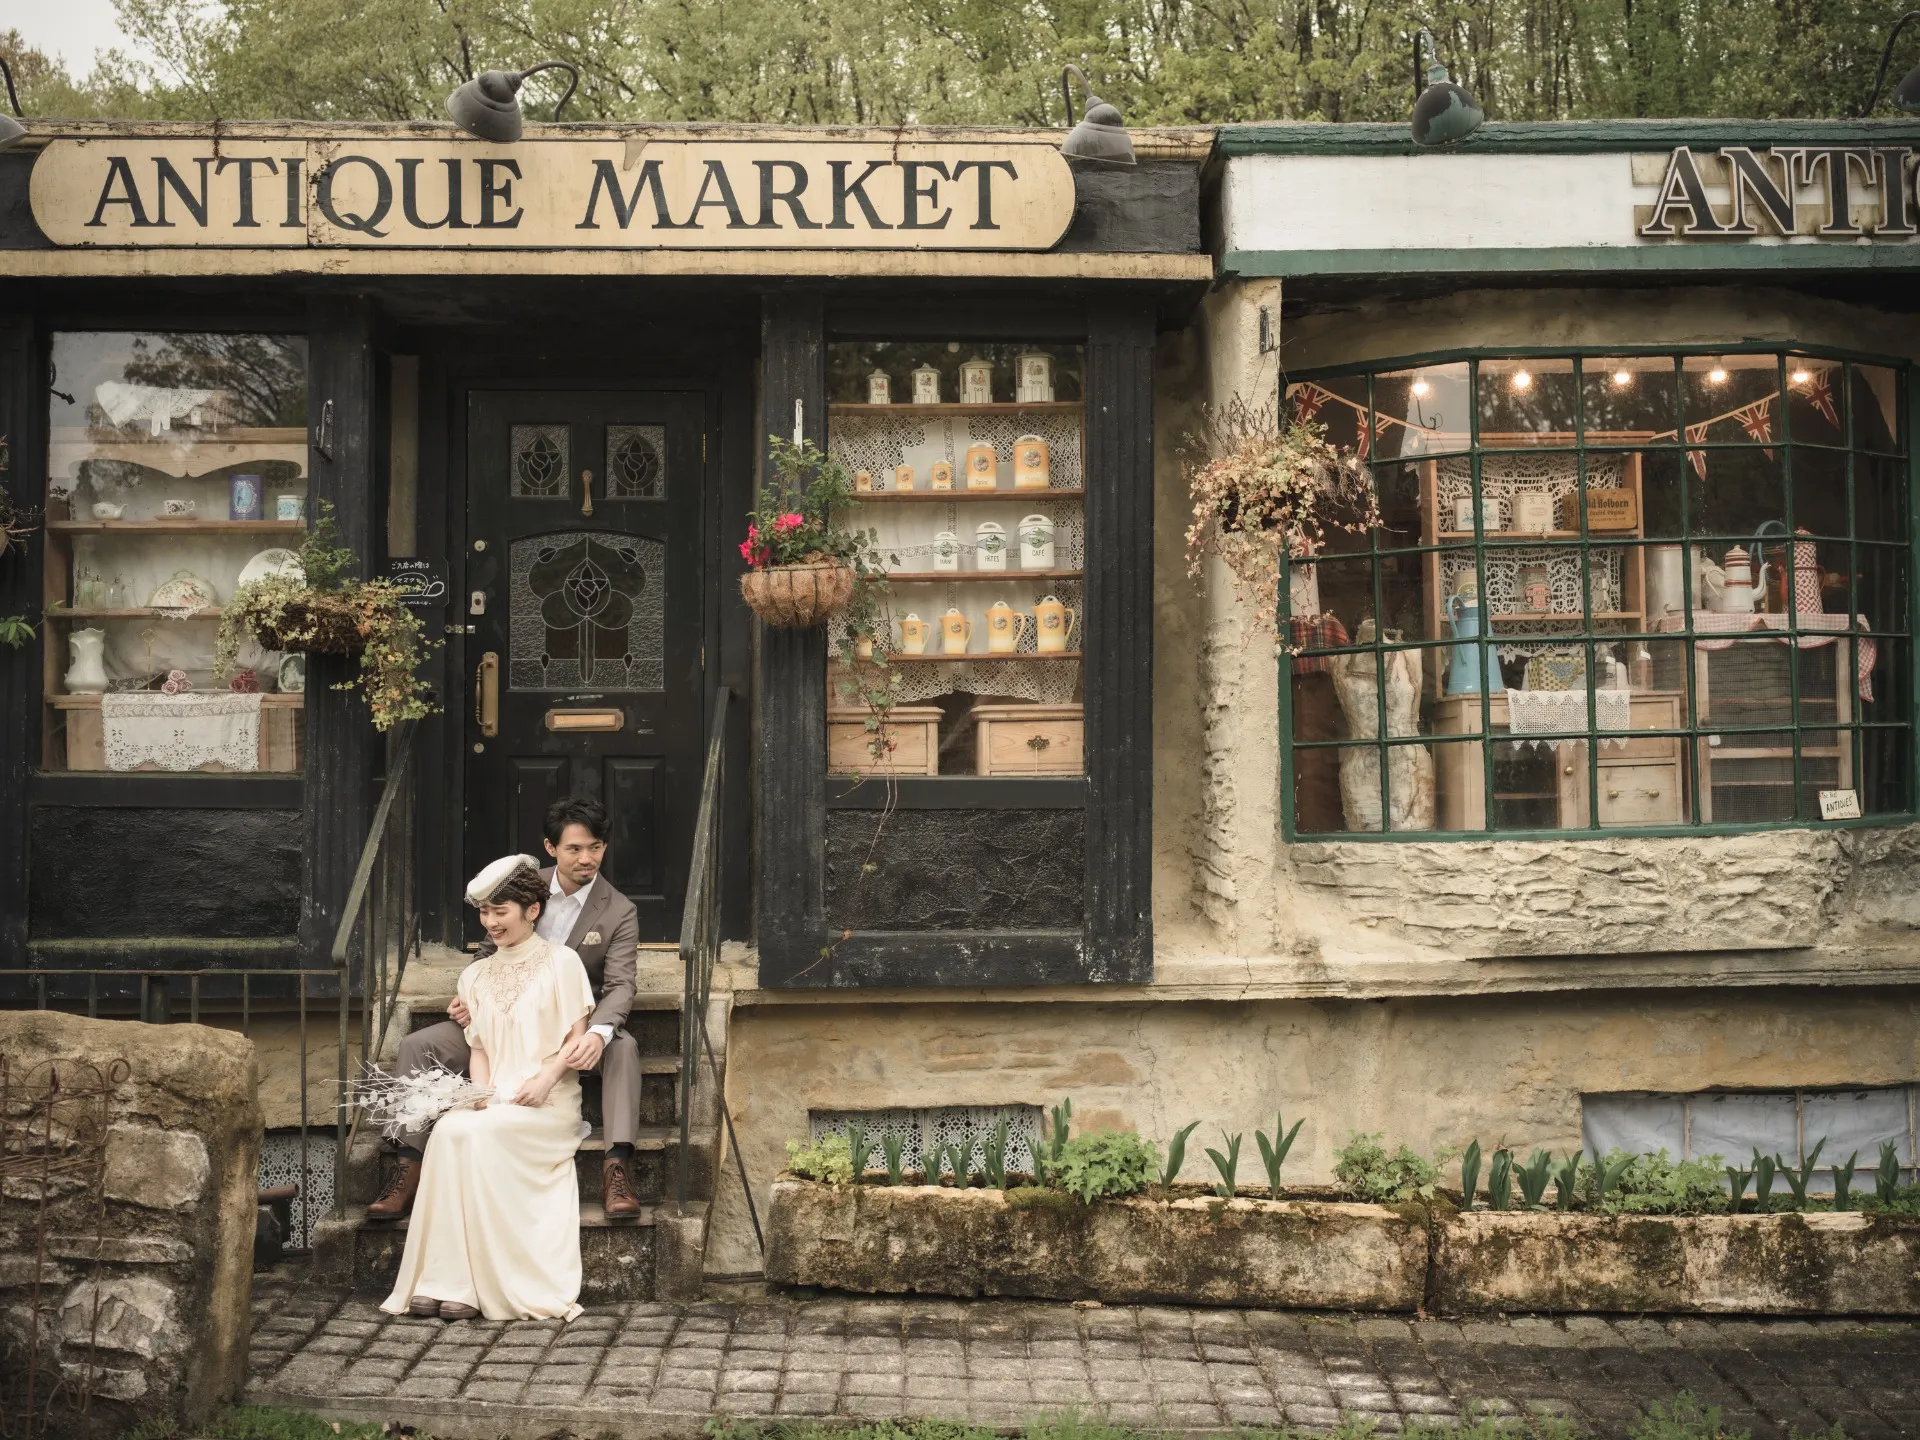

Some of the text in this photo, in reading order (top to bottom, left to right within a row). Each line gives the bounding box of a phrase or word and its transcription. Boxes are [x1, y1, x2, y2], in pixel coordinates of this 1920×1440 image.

[83, 155, 1019, 238] ANTIQUE MARKET
[1639, 145, 1920, 236] ANTI
[1597, 499, 1629, 508] Holborn
[1826, 796, 1852, 813] ANTIQUES
